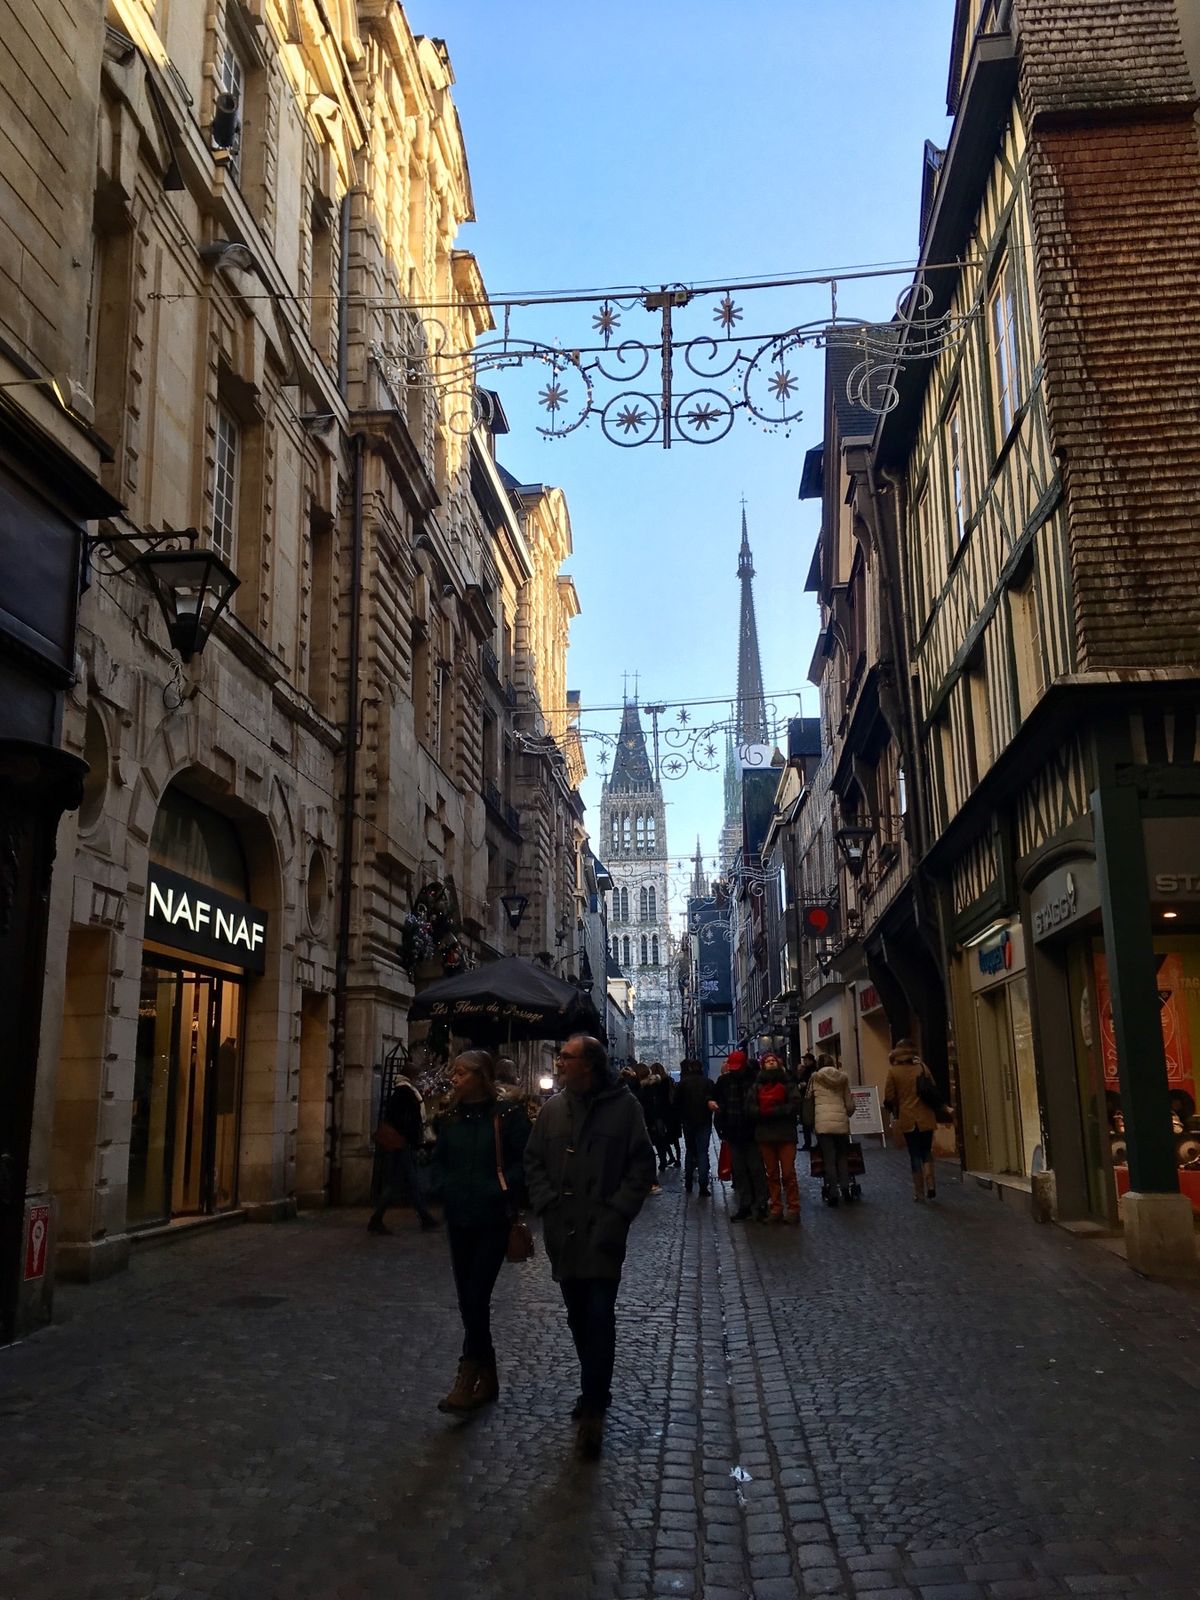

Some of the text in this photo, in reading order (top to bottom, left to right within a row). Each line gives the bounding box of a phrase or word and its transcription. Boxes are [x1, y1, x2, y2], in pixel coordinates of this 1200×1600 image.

[1032, 877, 1077, 934] STAGGY
[1155, 873, 1200, 892] ST
[148, 881, 265, 952] NAF NAF
